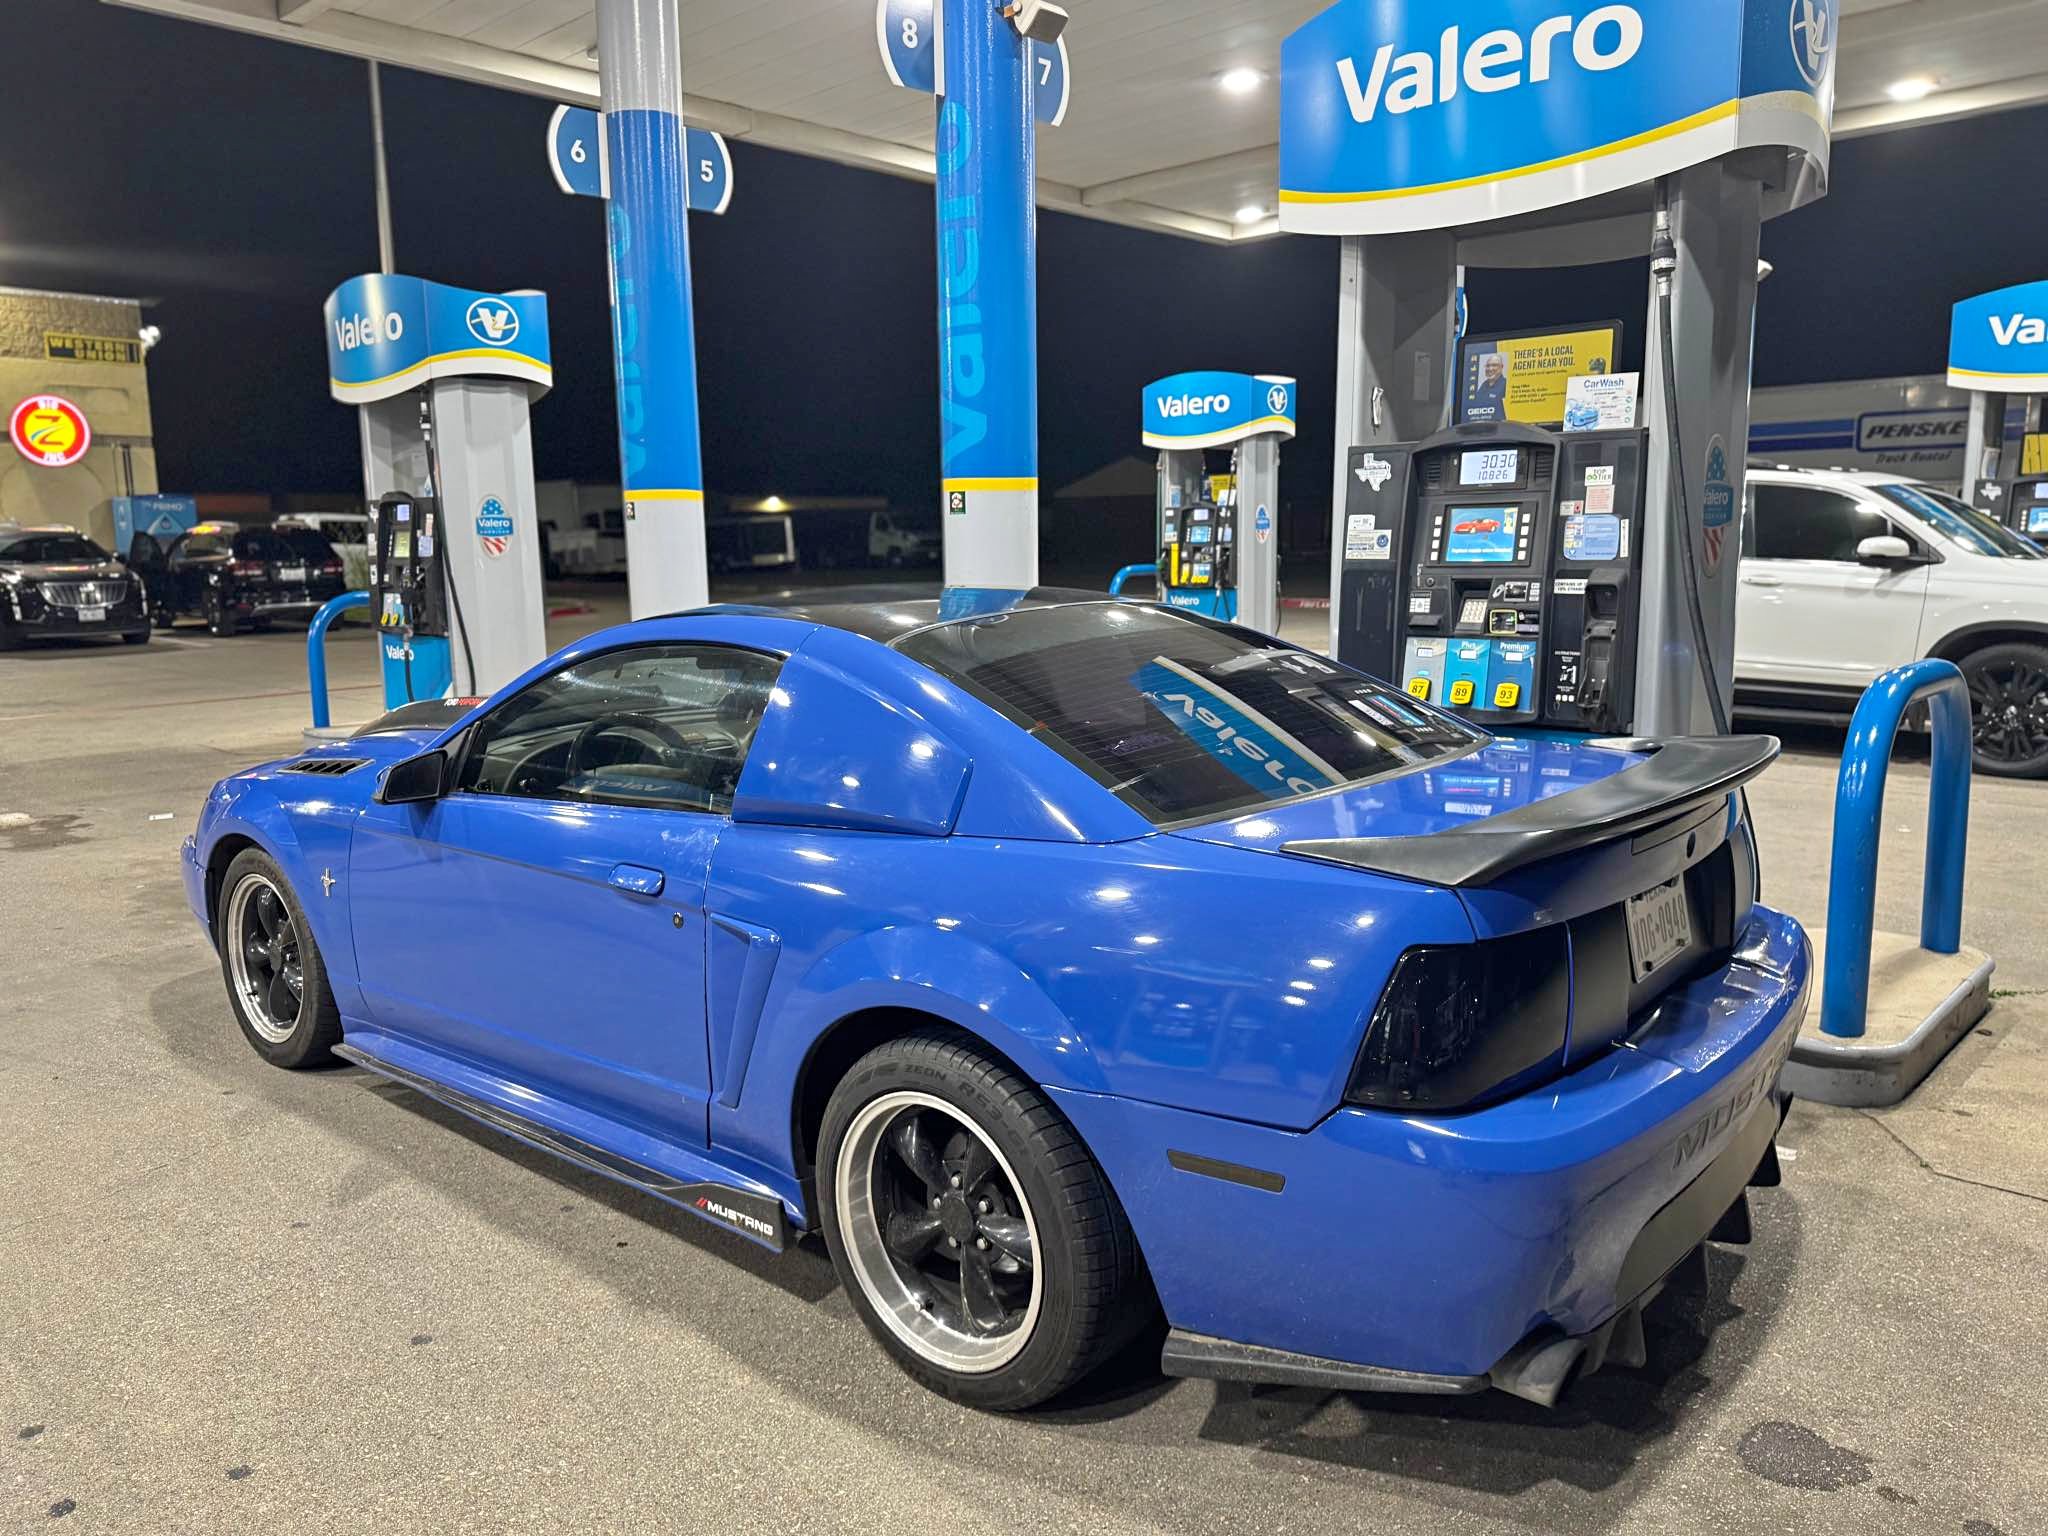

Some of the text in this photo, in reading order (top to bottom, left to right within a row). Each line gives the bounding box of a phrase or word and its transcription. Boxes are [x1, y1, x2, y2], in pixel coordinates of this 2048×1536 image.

[902, 18, 918, 49] 8
[1336, 4, 1643, 123] Valero
[1037, 58, 1052, 86] 7
[570, 139, 586, 164] 6
[700, 160, 714, 183] 5
[1988, 313, 2048, 345] Va
[49, 337, 127, 350] WESTERN
[75, 350, 126, 362] UNION
[1513, 345, 1574, 359] THERE'S A LOCAL
[1512, 357, 1575, 371] AGENT NEAR YOU.
[1583, 378, 1624, 389] CarWash
[1157, 394, 1231, 418] Valero
[1467, 407, 1495, 416] GEICO
[1866, 420, 1968, 440] PENSKE
[478, 518, 510, 528] Valero
[1170, 595, 1199, 605] Valero
[386, 645, 414, 661] Valeo
[1500, 642, 1529, 651] Premium
[1411, 685, 1425, 694] 87
[1454, 688, 1468, 697] 89
[1499, 690, 1513, 700] 93
[904, 1063, 948, 1081] ZEON
[707, 1200, 774, 1236] MUSTANG
